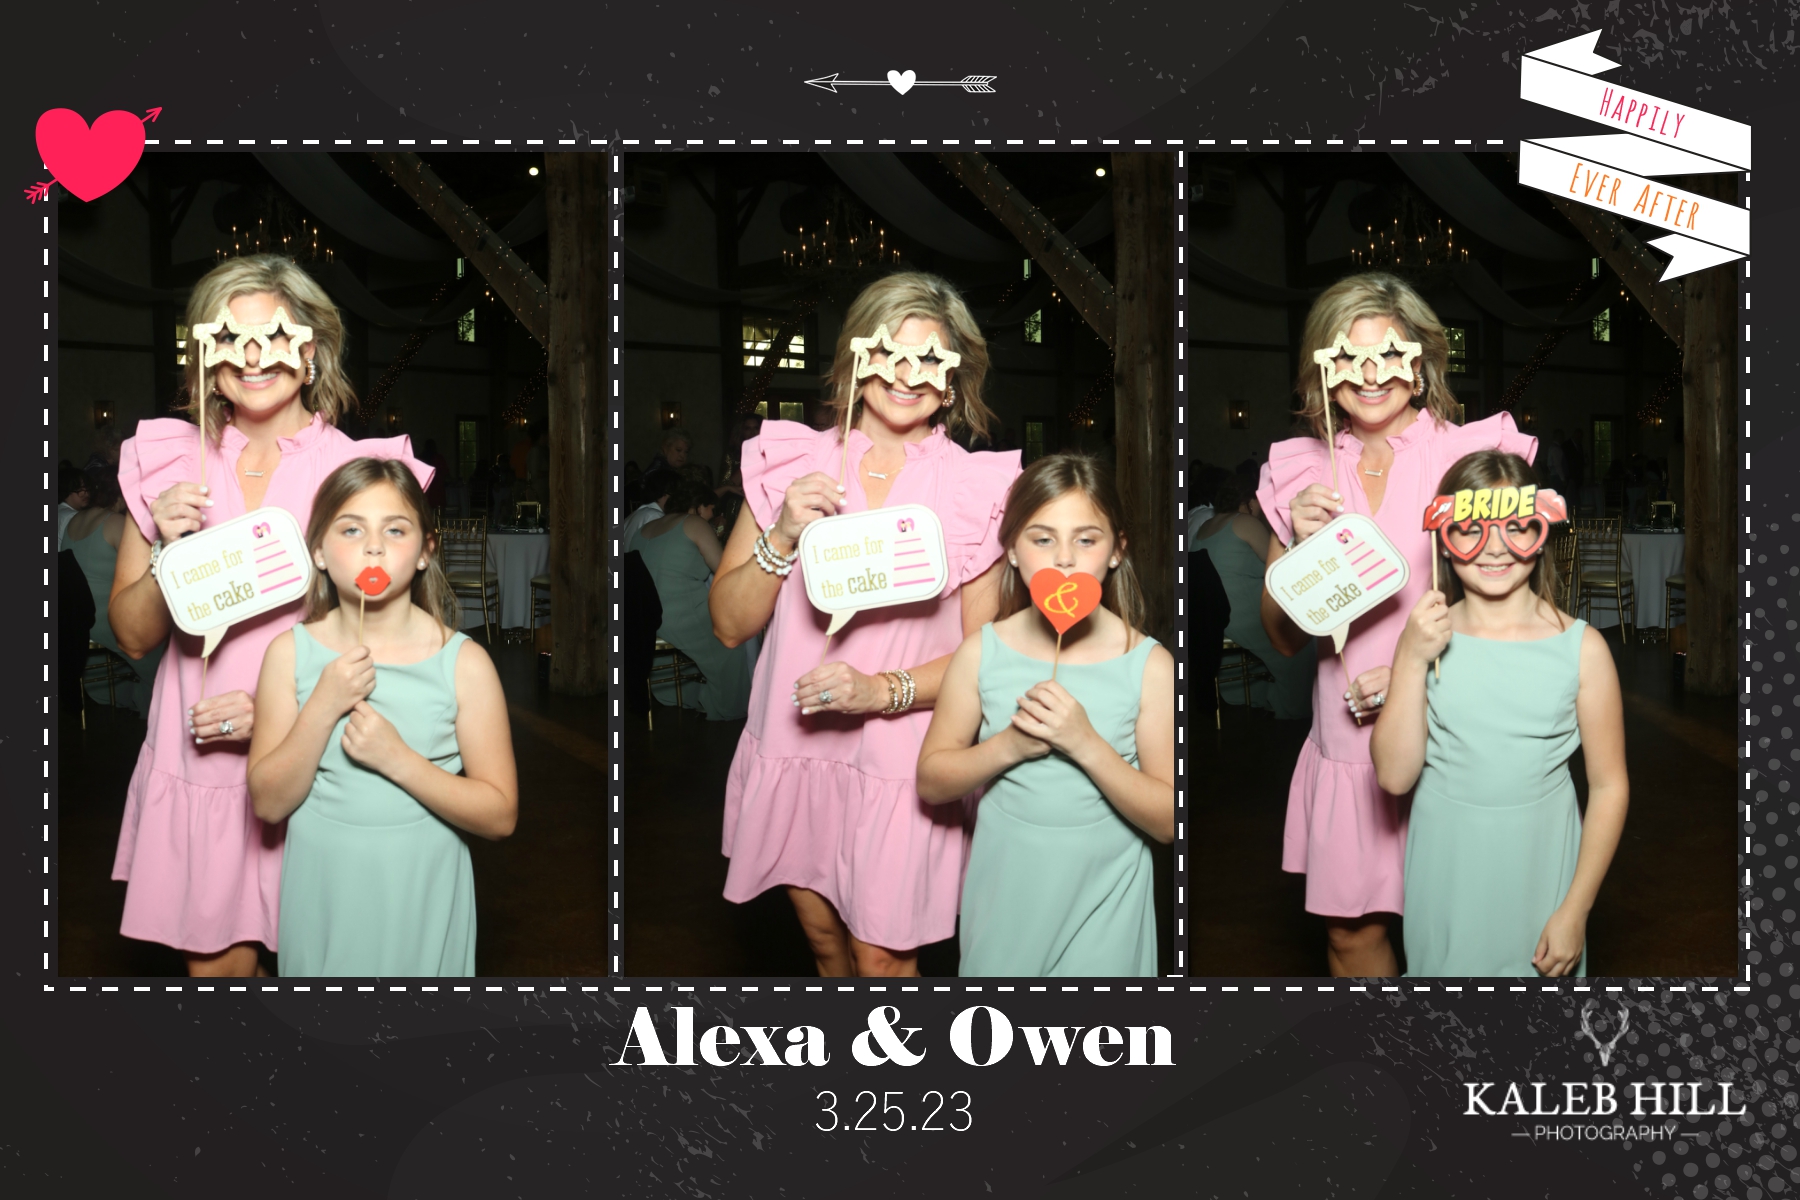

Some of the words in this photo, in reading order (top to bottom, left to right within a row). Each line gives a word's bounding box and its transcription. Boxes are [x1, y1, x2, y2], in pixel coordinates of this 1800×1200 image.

[1453, 484, 1537, 522] BRIDE
[170, 570, 181, 589] I
[182, 558, 221, 585] came
[222, 549, 244, 569] for
[812, 545, 820, 564] I
[823, 544, 861, 562] came
[864, 536, 884, 556] for
[821, 579, 844, 599] the
[847, 567, 888, 595] cake
[1280, 586, 1294, 602] I
[1291, 569, 1324, 596] came
[1318, 556, 1341, 576] for
[187, 601, 212, 622] the
[212, 580, 255, 612] cake
[1043, 581, 1079, 618] &
[1306, 605, 1330, 626] the
[1325, 582, 1363, 613] cake
